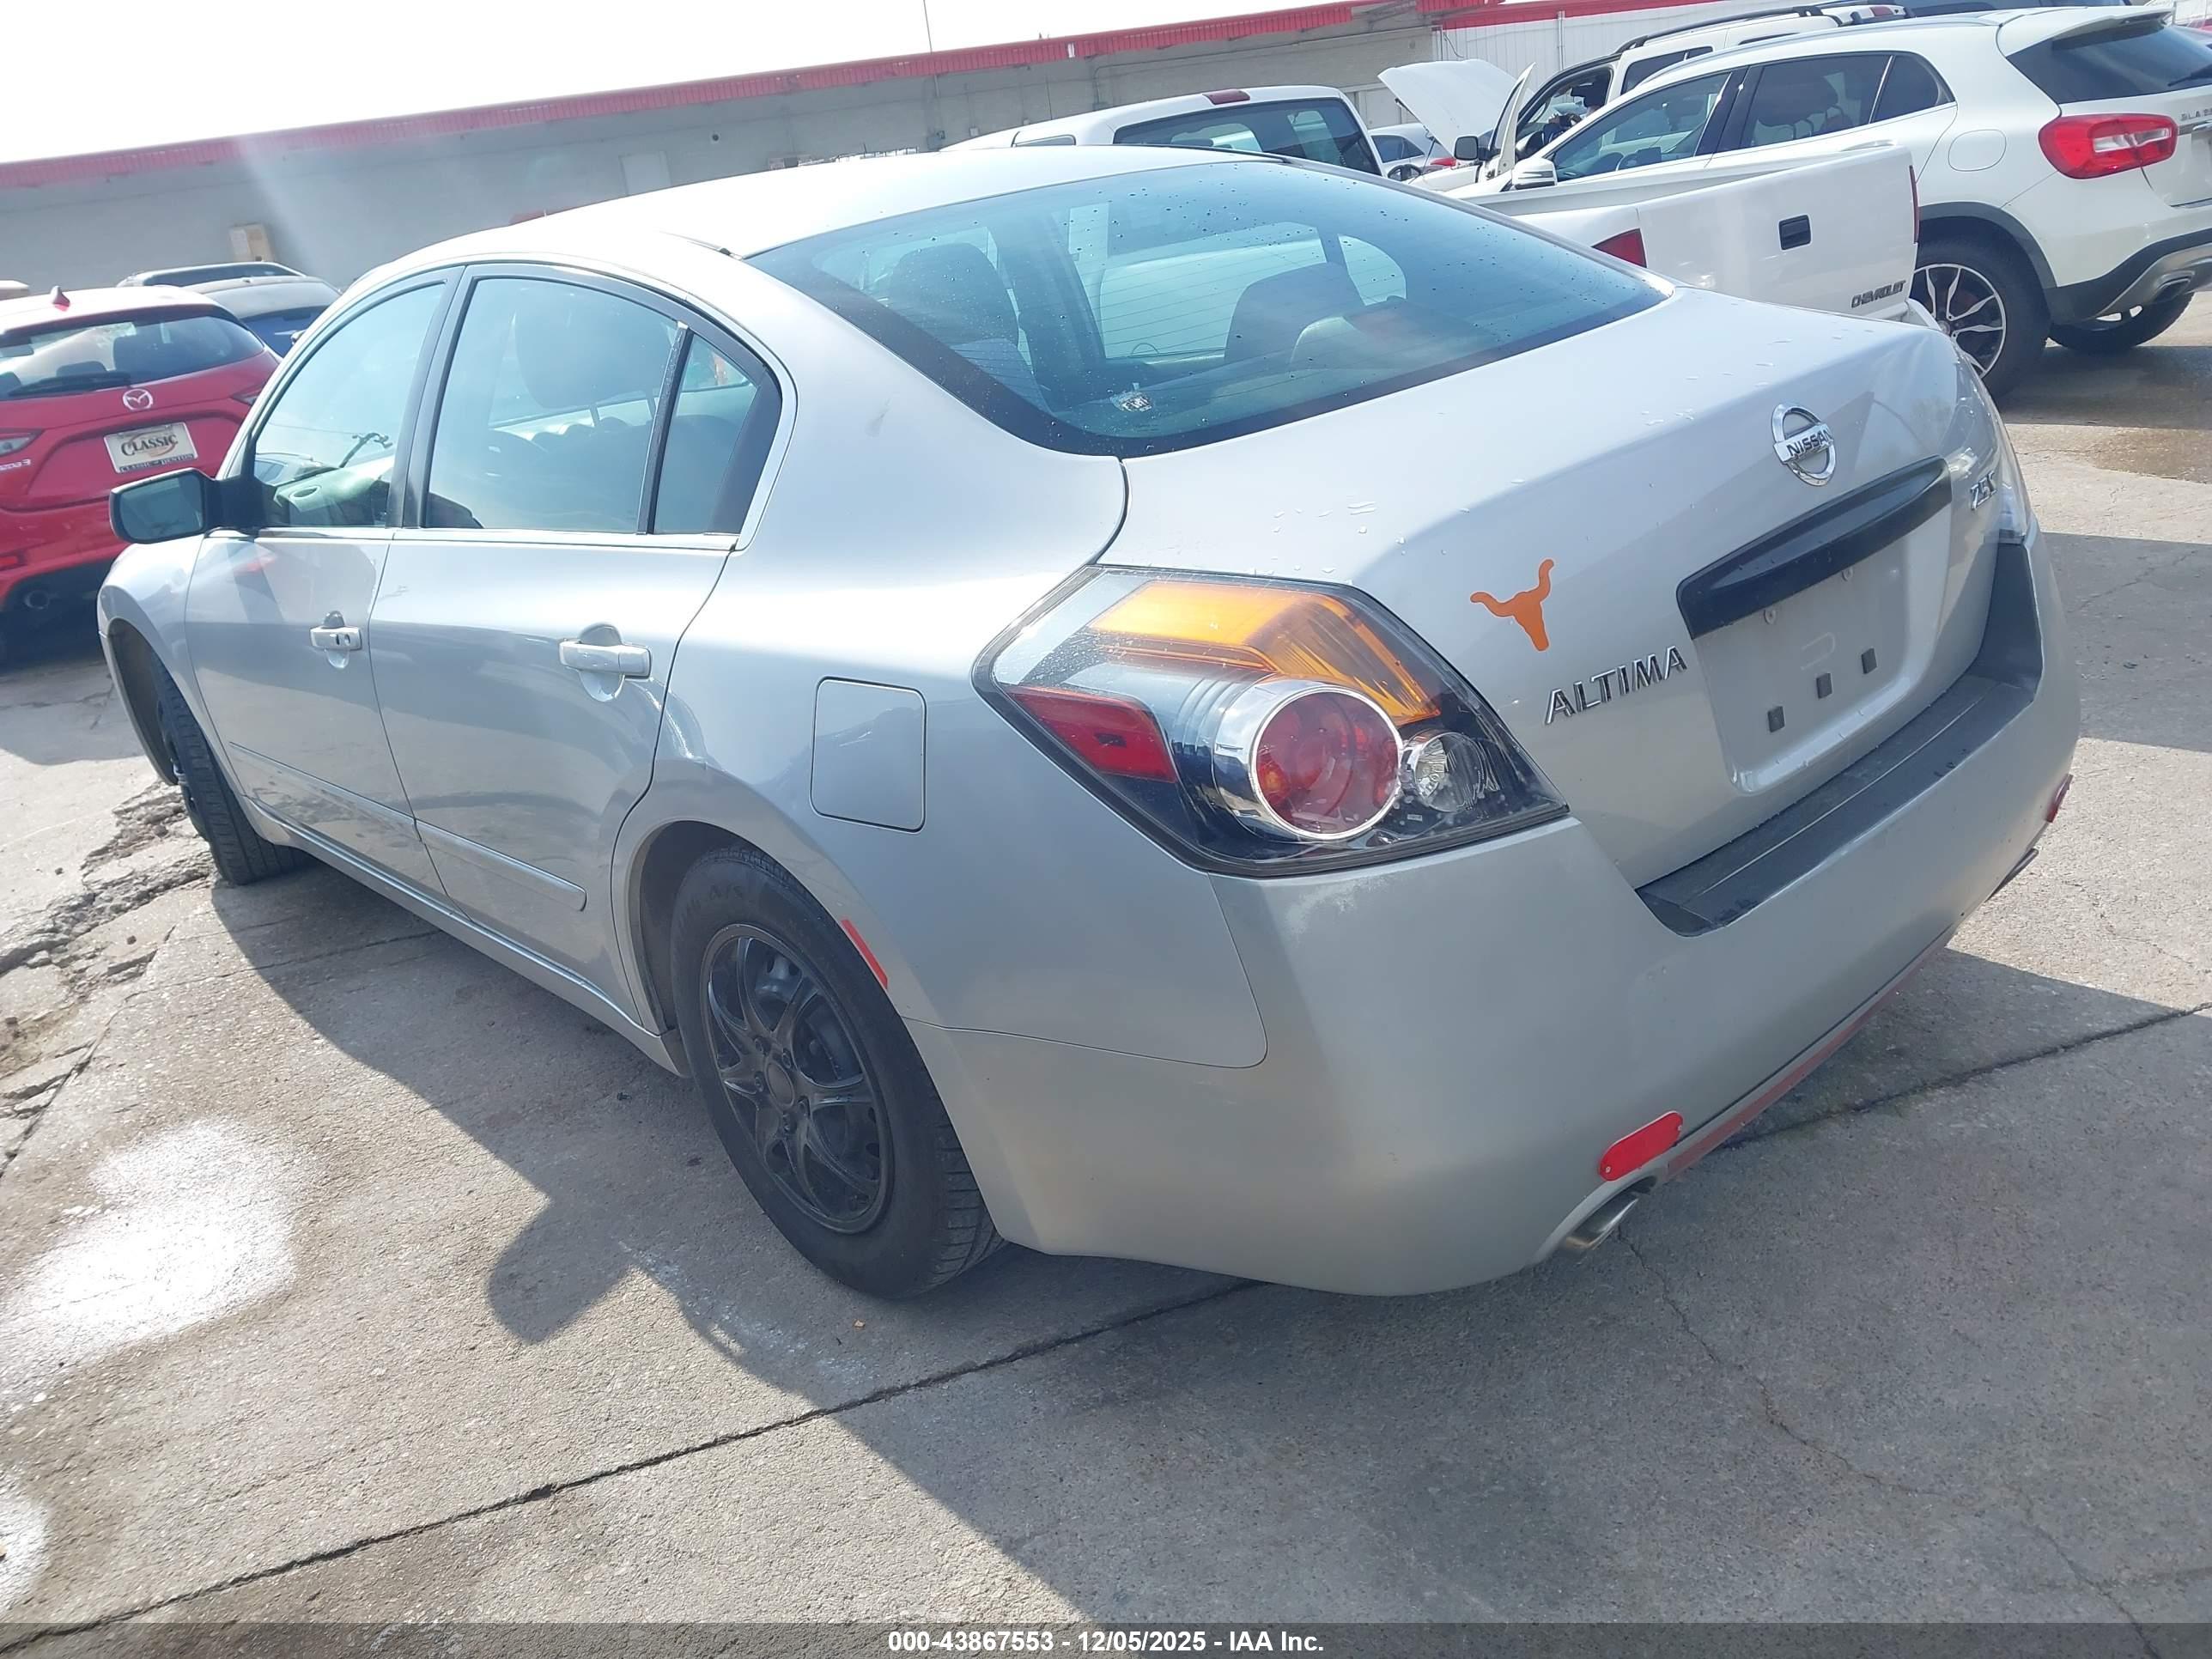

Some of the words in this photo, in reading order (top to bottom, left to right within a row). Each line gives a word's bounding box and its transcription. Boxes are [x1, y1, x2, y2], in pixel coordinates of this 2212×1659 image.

[1851, 279, 1906, 308] CHEVROLET
[1786, 428, 1833, 457] NISSAN
[1545, 645, 1688, 726] ALTIMA
